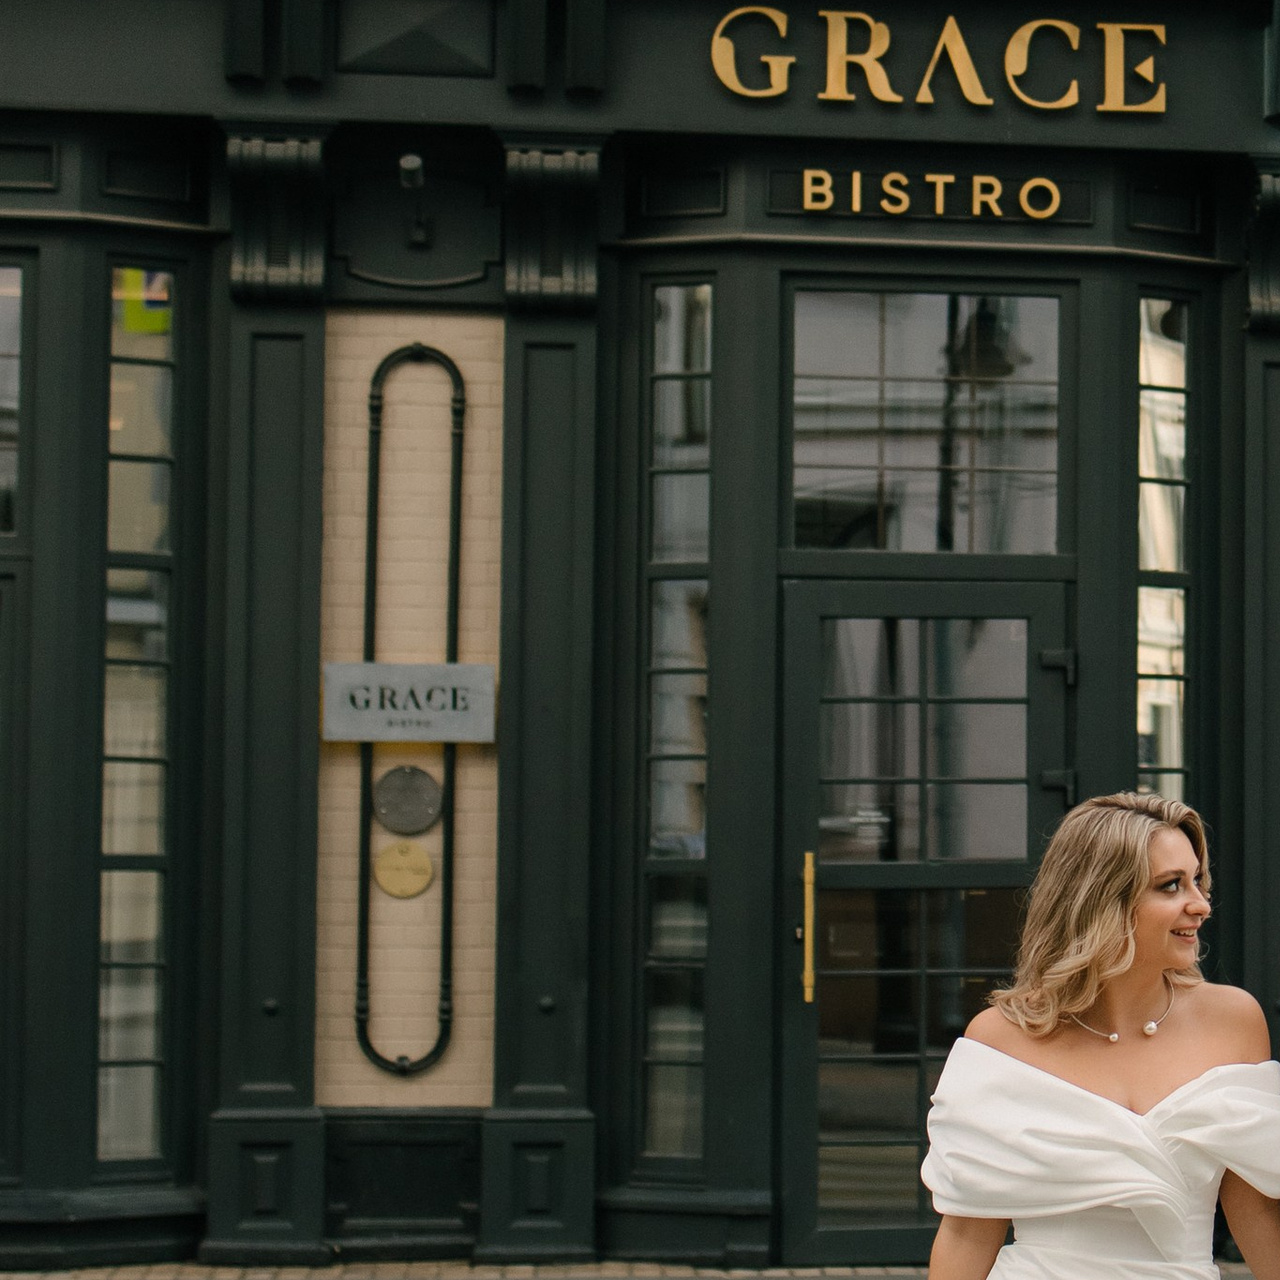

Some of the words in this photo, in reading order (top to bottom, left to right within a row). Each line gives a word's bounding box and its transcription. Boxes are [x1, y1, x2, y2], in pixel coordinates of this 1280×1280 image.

[711, 6, 1167, 113] GRACE
[803, 169, 1061, 219] BISTRO
[349, 685, 469, 711] GRACE
